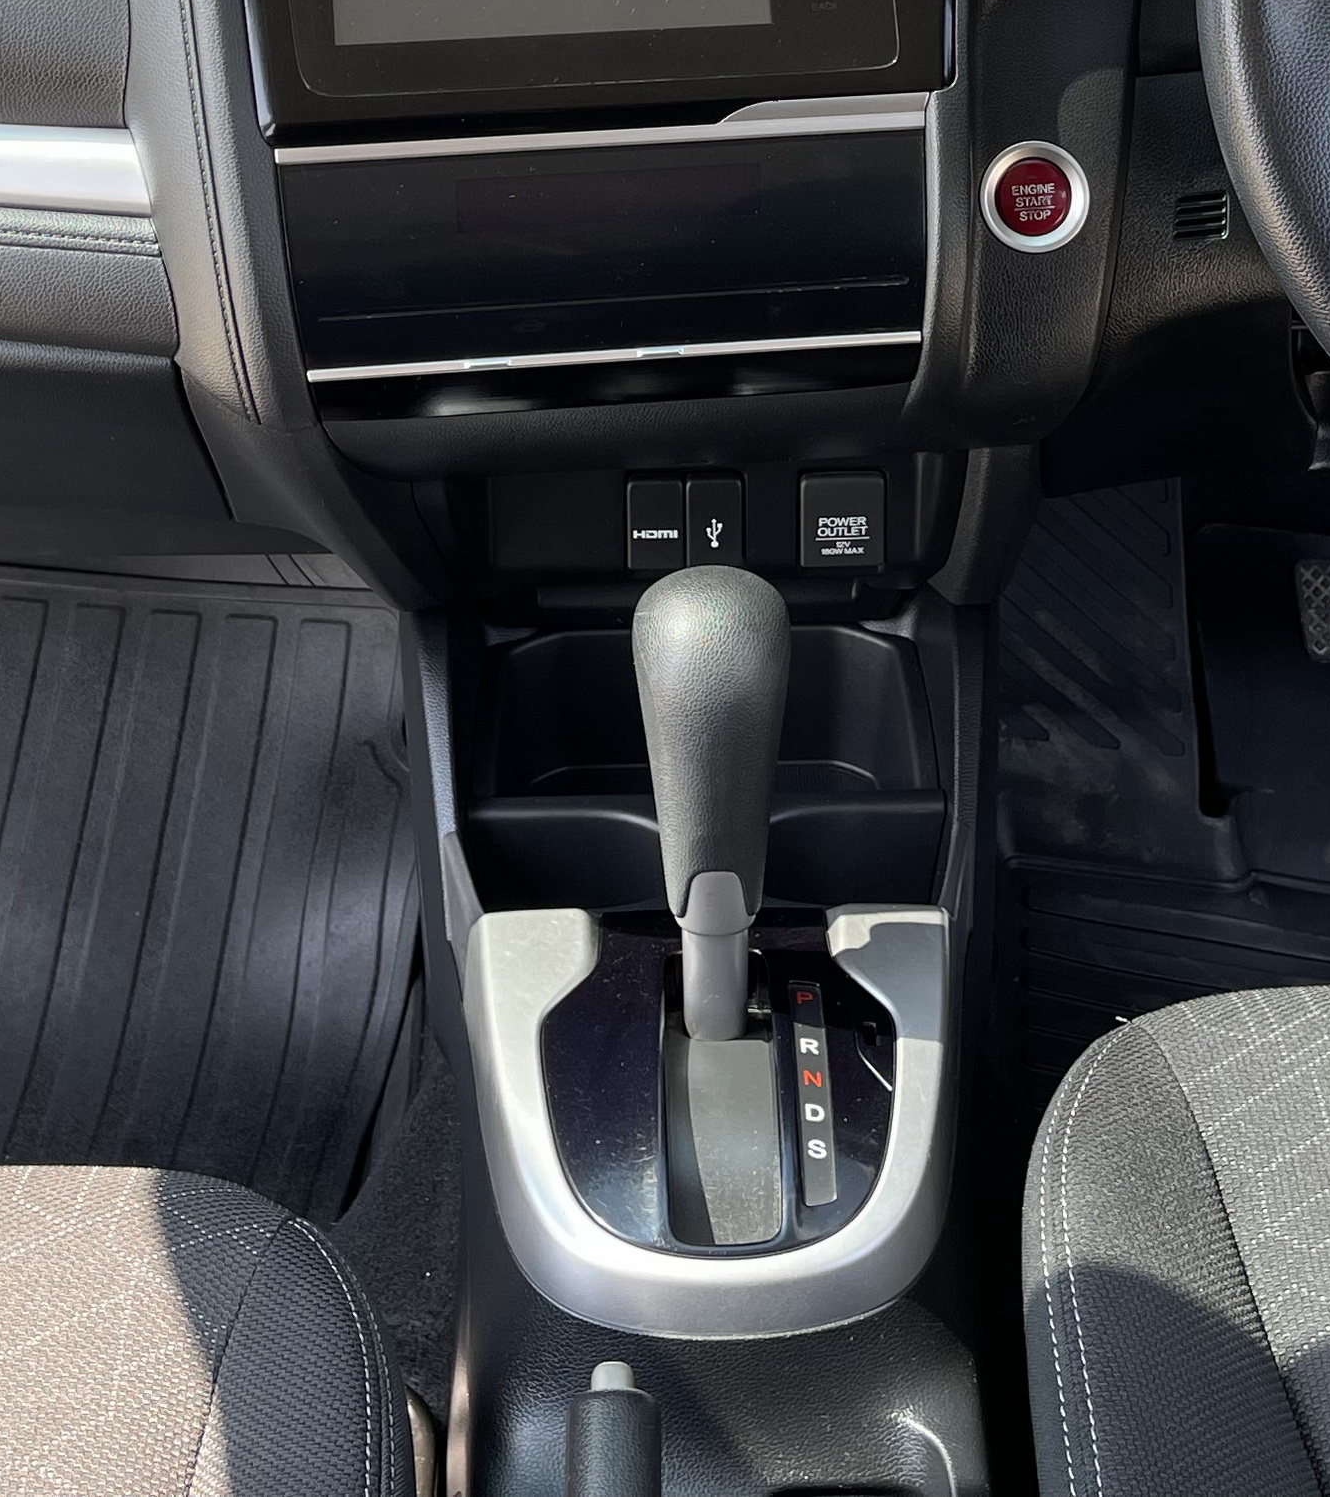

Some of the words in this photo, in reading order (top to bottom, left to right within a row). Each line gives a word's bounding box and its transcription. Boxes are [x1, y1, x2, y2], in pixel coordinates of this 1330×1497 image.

[1011, 182, 1056, 197] ENGINE
[1015, 195, 1054, 208] START
[1019, 209, 1051, 222] STOP
[818, 516, 868, 527] POWER
[632, 529, 679, 540] HDMI
[817, 526, 869, 537] OUTLET
[843, 547, 865, 555] MAX
[796, 990, 814, 1005] P
[799, 1037, 820, 1056] R
[802, 1069, 823, 1088] N
[804, 1103, 826, 1123] D
[807, 1139, 828, 1160] S
